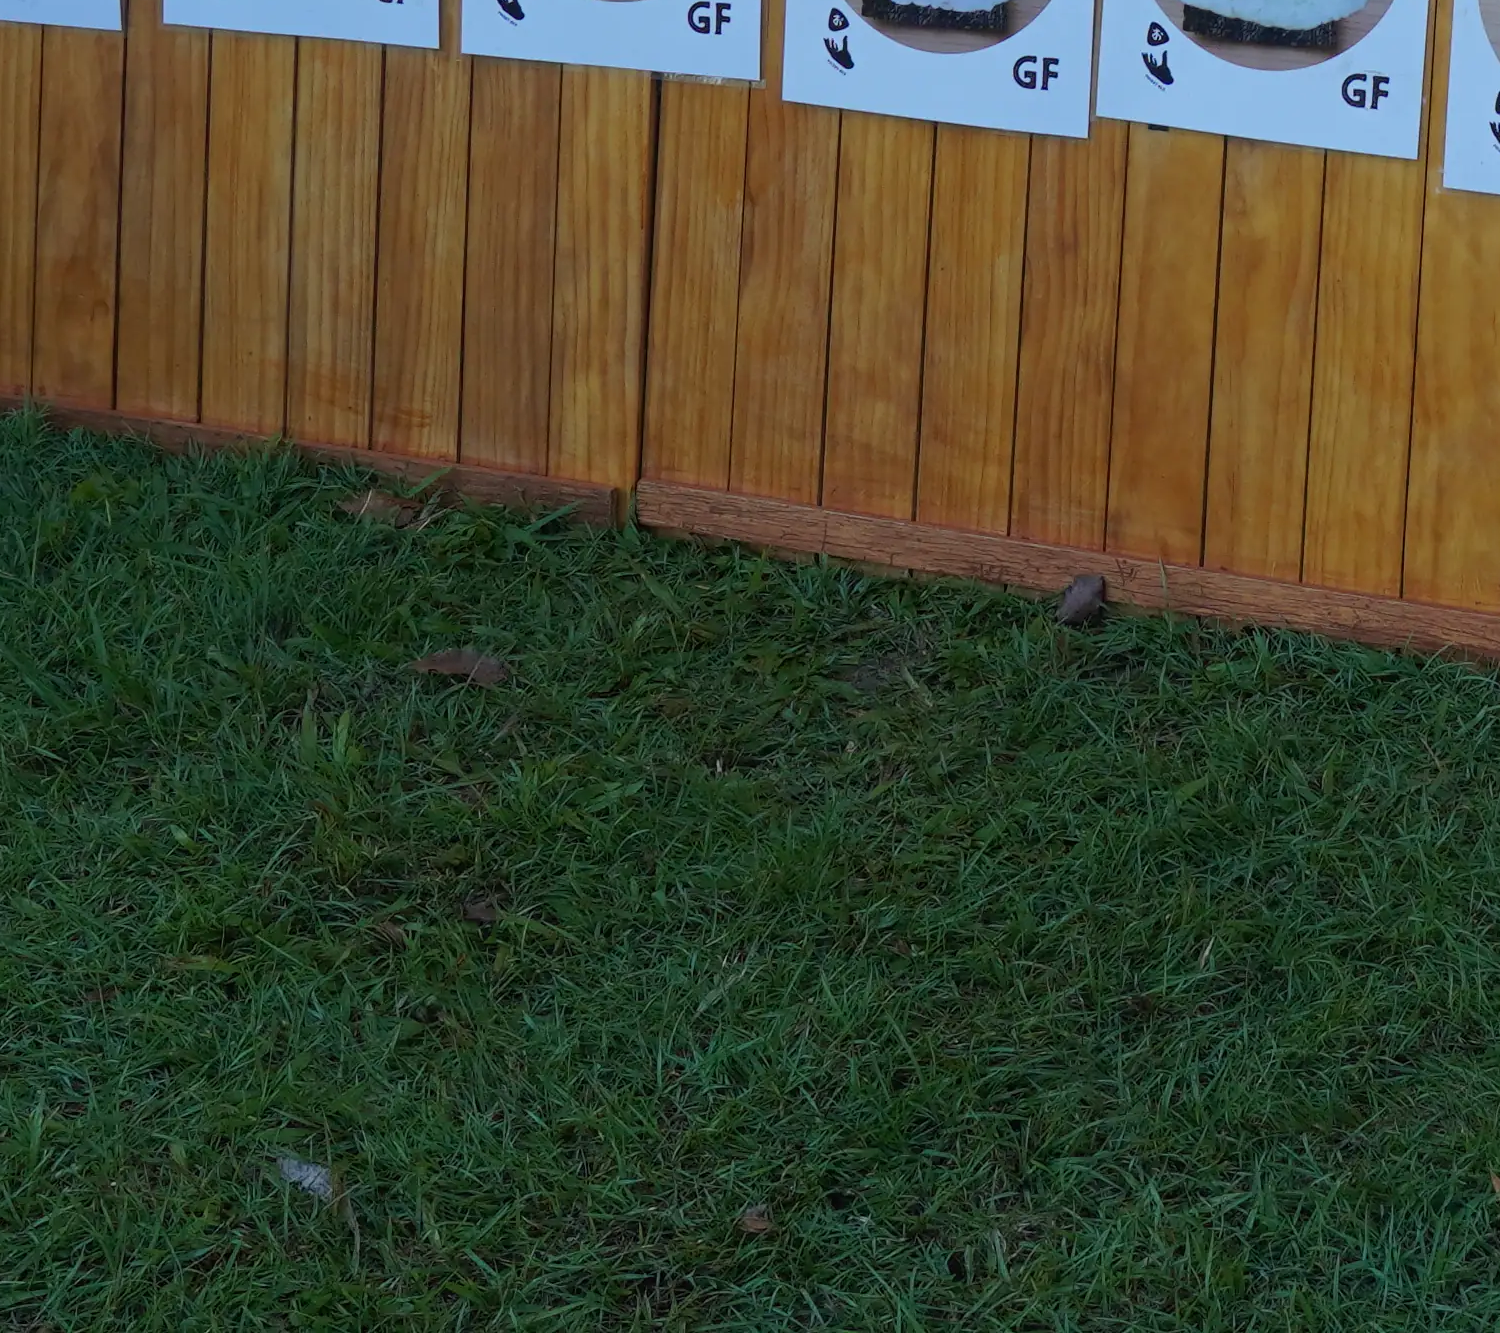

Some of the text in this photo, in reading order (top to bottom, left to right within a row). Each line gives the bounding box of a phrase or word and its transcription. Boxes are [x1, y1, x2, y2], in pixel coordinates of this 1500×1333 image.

[687, 0, 732, 36] GF
[1013, 55, 1059, 91] GF
[1341, 72, 1390, 110] GF
